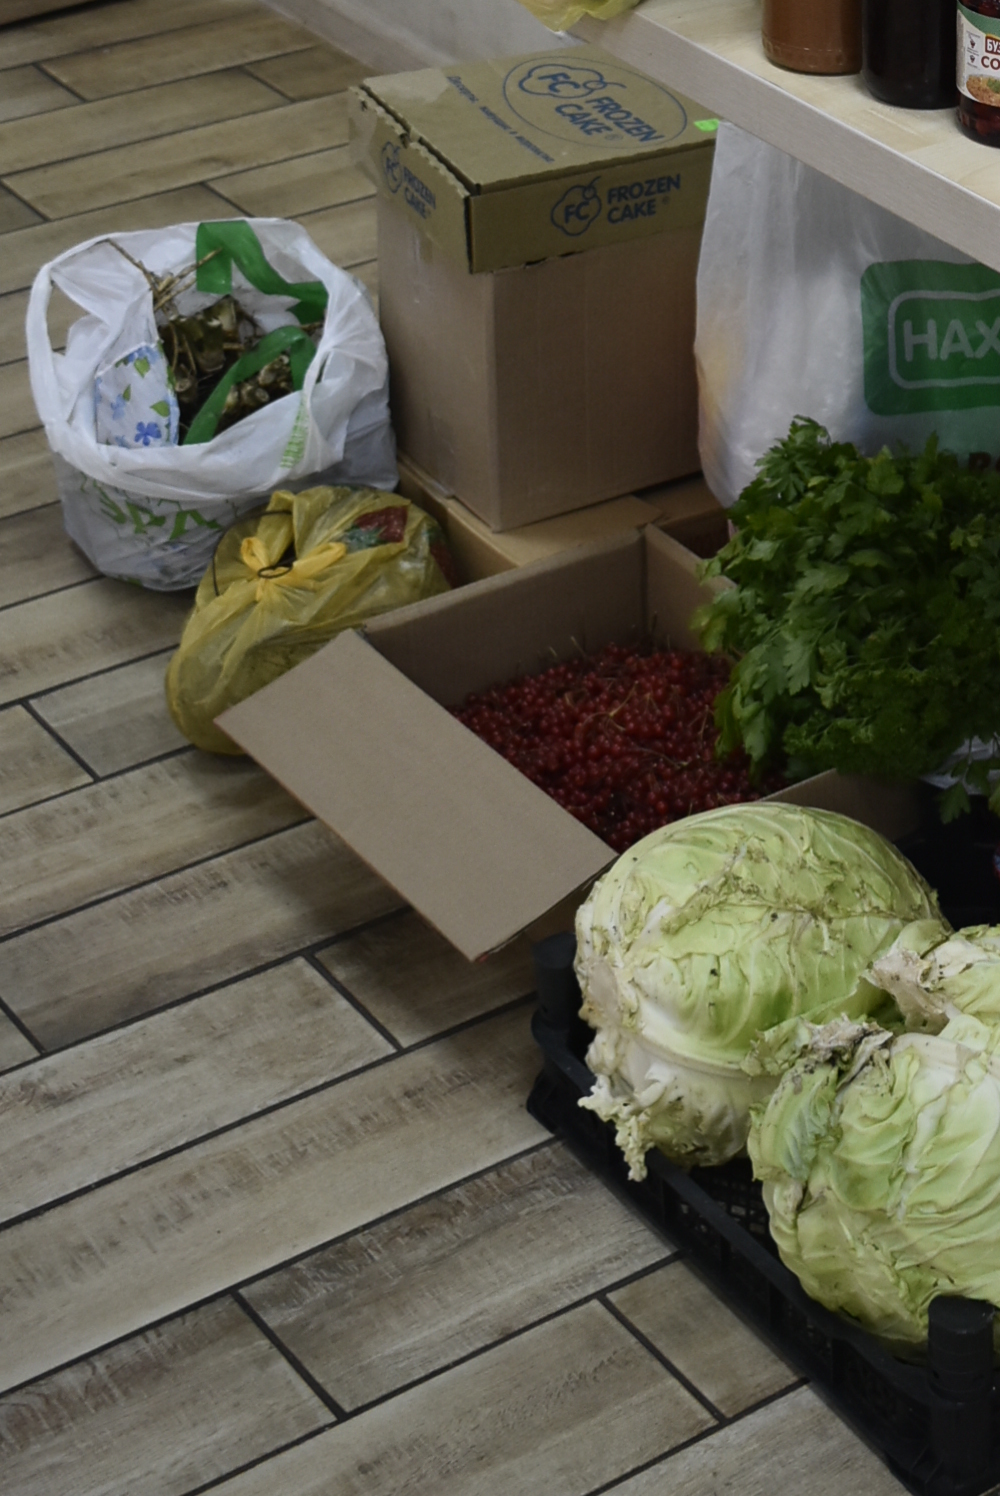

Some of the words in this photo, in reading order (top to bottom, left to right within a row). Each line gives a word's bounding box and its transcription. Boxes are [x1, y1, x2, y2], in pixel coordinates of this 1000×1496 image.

[555, 103, 611, 137] CAKE
[585, 95, 667, 143] FROZEN
[607, 173, 681, 205] FROZEN
[564, 198, 591, 224] FC
[607, 199, 657, 225] CAKE
